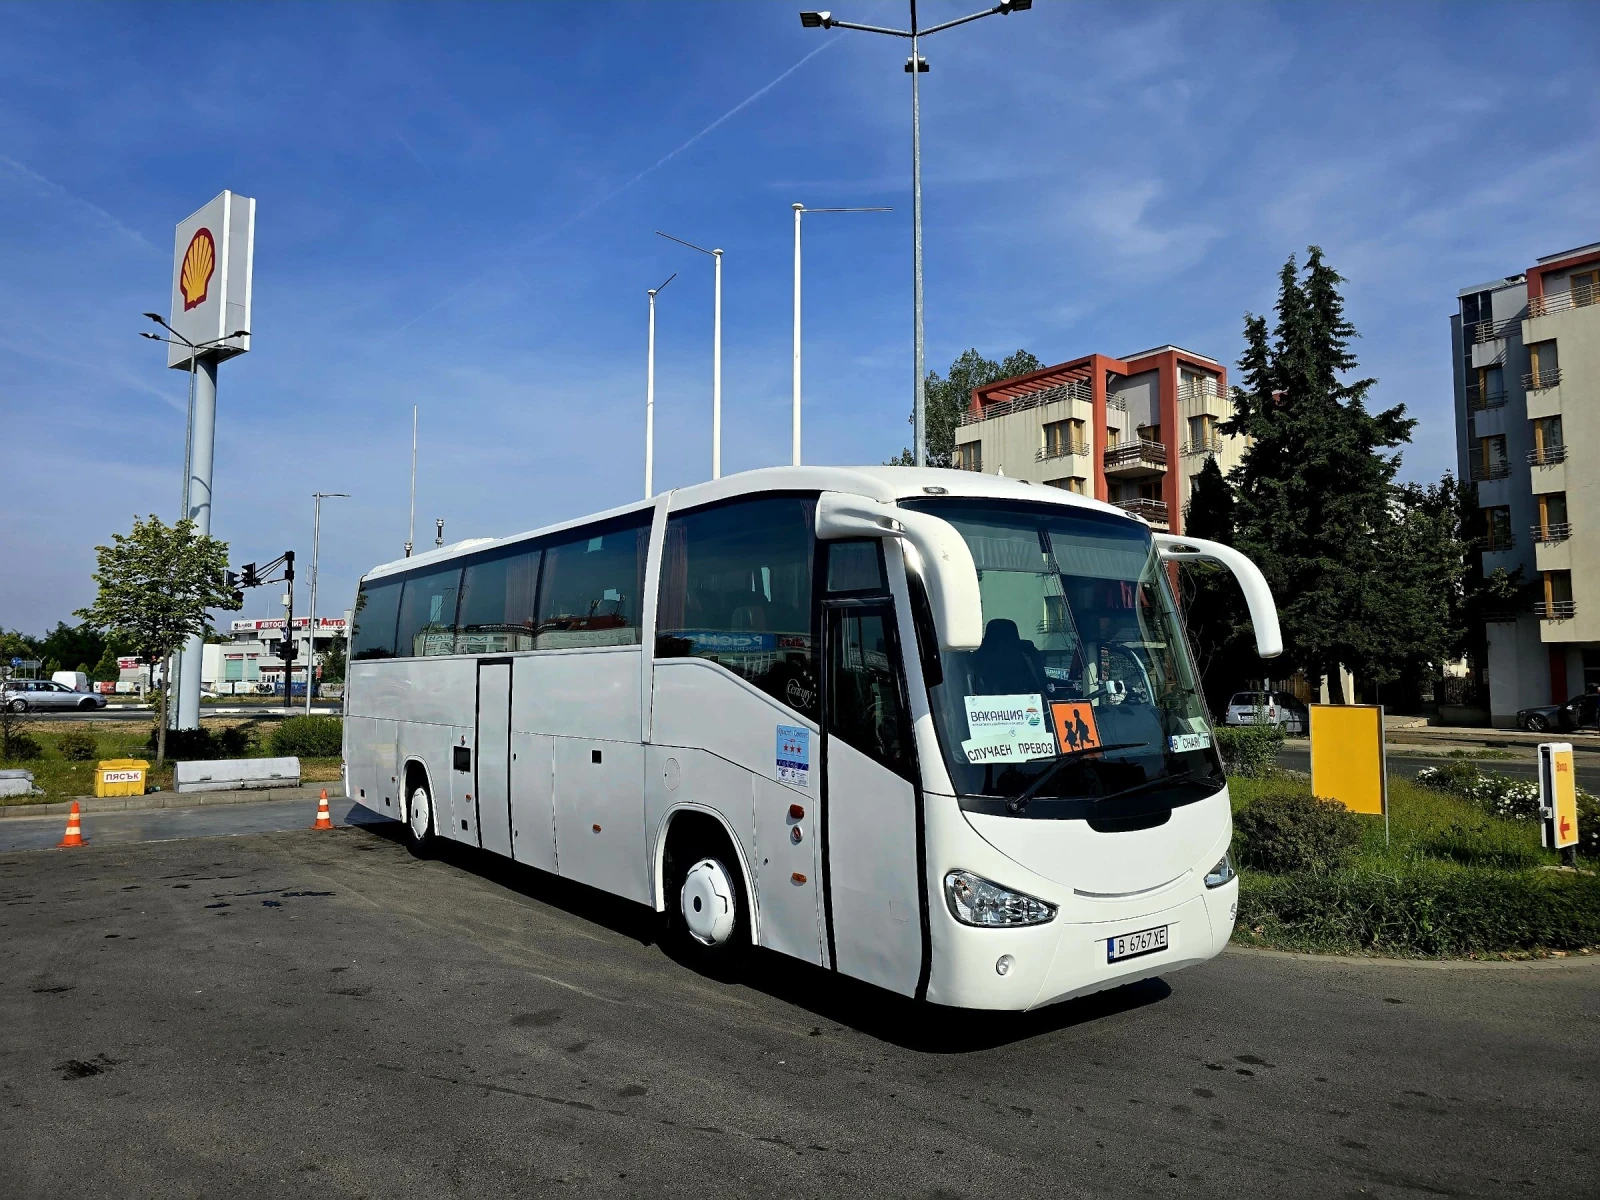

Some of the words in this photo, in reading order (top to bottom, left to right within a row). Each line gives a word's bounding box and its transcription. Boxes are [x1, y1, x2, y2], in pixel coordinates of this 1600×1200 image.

[260, 620, 302, 629] АВТОСЕИЗ
[970, 710, 1024, 722] ВАКАНЦИЯ
[967, 744, 1012, 761] СЛУЧАЕН
[1018, 742, 1054, 755] ПРЕВОЗ
[105, 772, 139, 781] ПЯСЪК
[1119, 939, 1125, 954] B
[1130, 932, 1152, 951] 6767
[1154, 929, 1165, 946] XE
